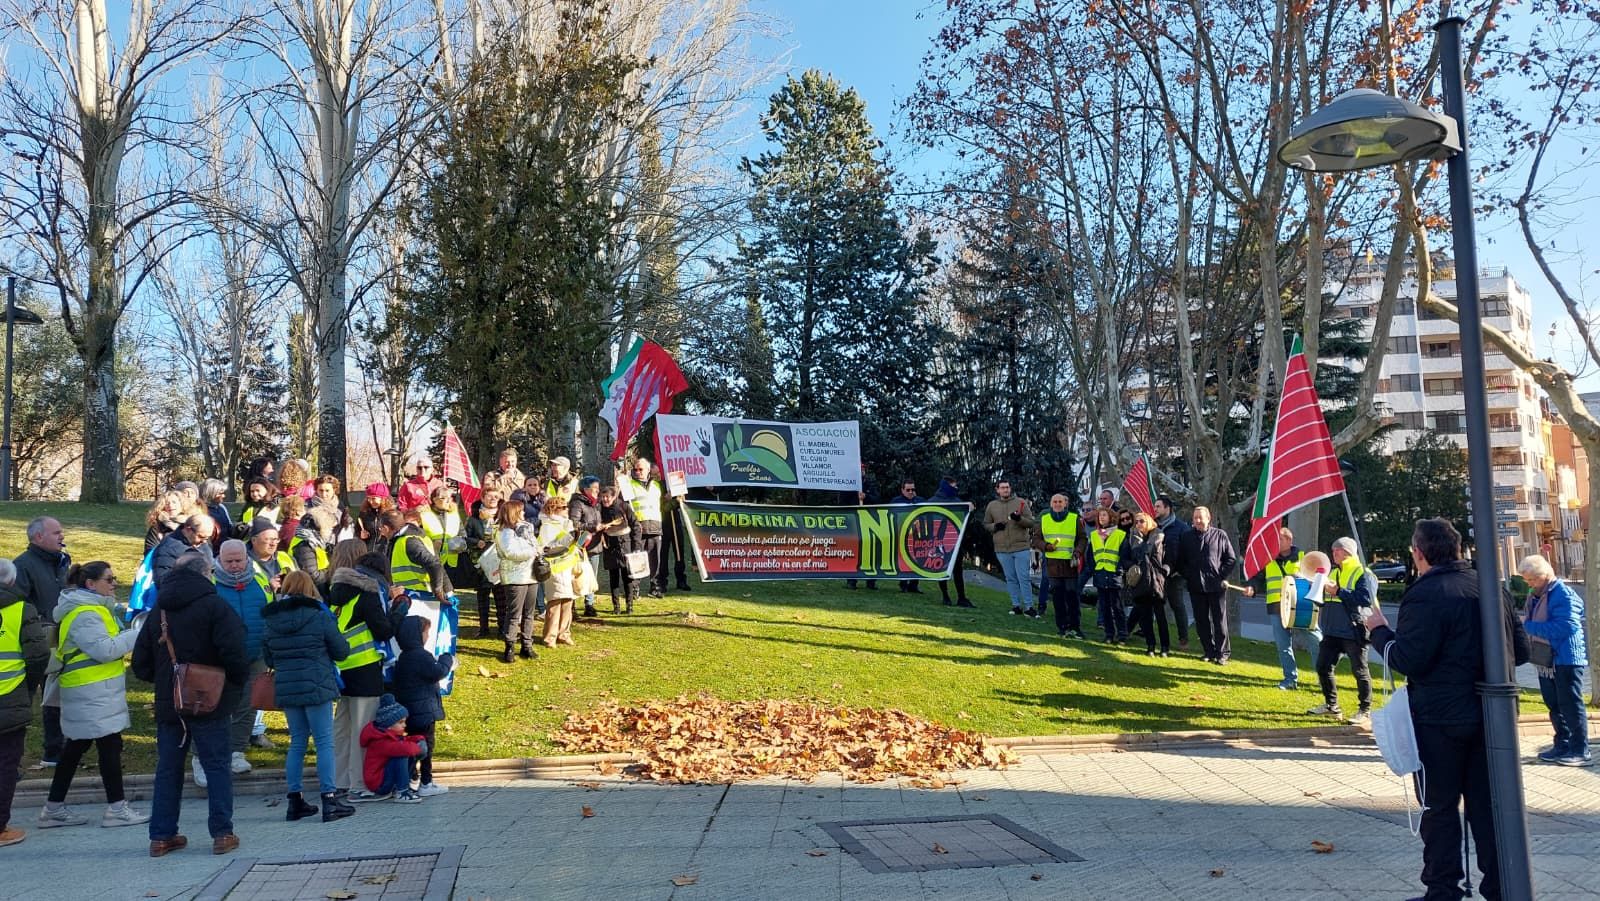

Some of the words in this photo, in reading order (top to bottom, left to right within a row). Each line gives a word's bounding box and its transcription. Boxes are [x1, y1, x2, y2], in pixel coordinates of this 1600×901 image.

[795, 427, 857, 438] ASOCIACIÓN
[663, 434, 691, 453] STOP
[730, 464, 761, 473] Pueblos
[748, 472, 772, 482] Sanos
[695, 511, 799, 529] JAMBRINA
[803, 515, 848, 529] DICE
[709, 533, 728, 545] Con
[728, 535, 760, 545] nuestra
[761, 534, 786, 545] salud
[799, 536, 809, 544] se
[704, 548, 746, 559] queremos
[747, 548, 761, 557] ser
[763, 547, 811, 557] estercolero
[812, 548, 823, 556] de
[823, 548, 855, 559] Europa.
[719, 558, 730, 569] Ni
[742, 558, 752, 568] tu
[753, 559, 780, 570] pueblo
[782, 559, 790, 568] ni
[802, 559, 811, 568] el
